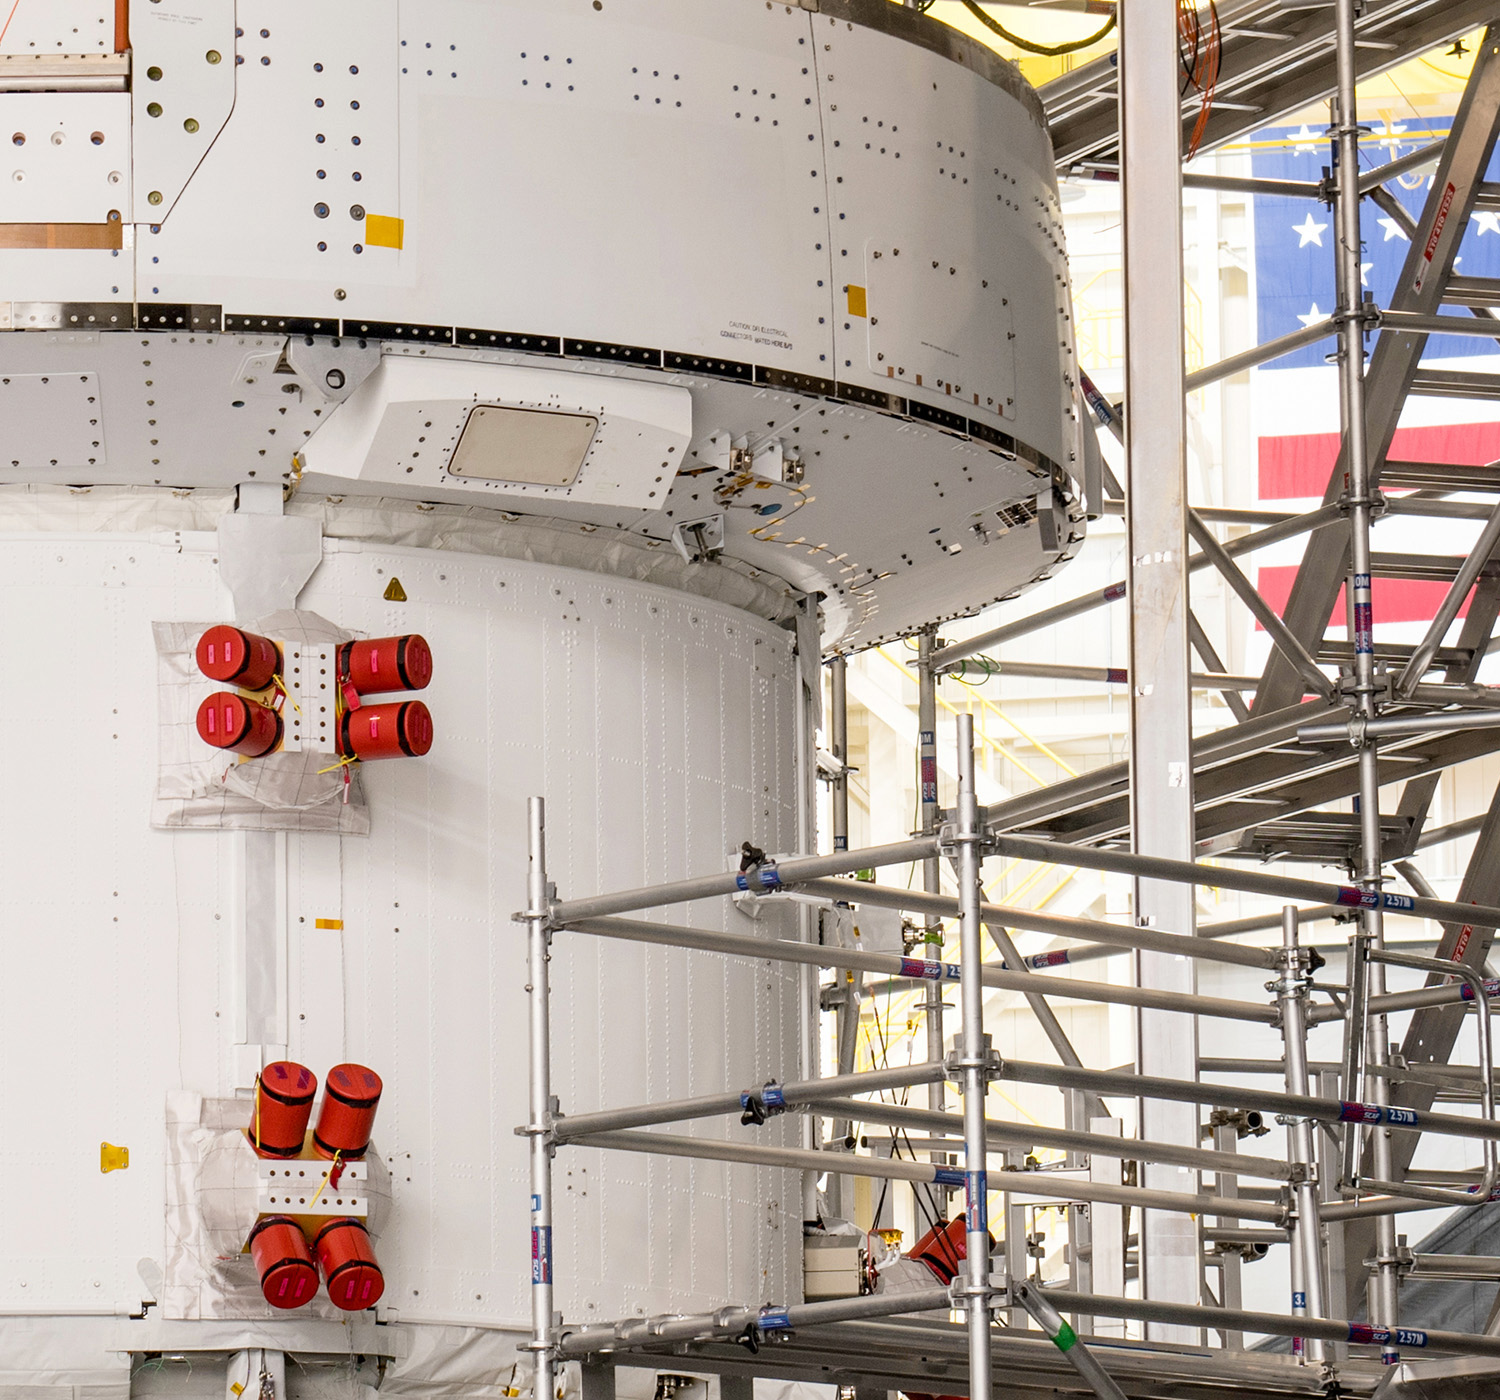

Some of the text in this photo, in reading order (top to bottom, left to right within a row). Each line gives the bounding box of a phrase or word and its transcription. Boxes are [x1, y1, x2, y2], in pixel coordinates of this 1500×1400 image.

[1387, 895, 1412, 908] 2.57M
[1390, 1109, 1414, 1122] 2.57M
[1399, 1332, 1424, 1345] 2.57M
